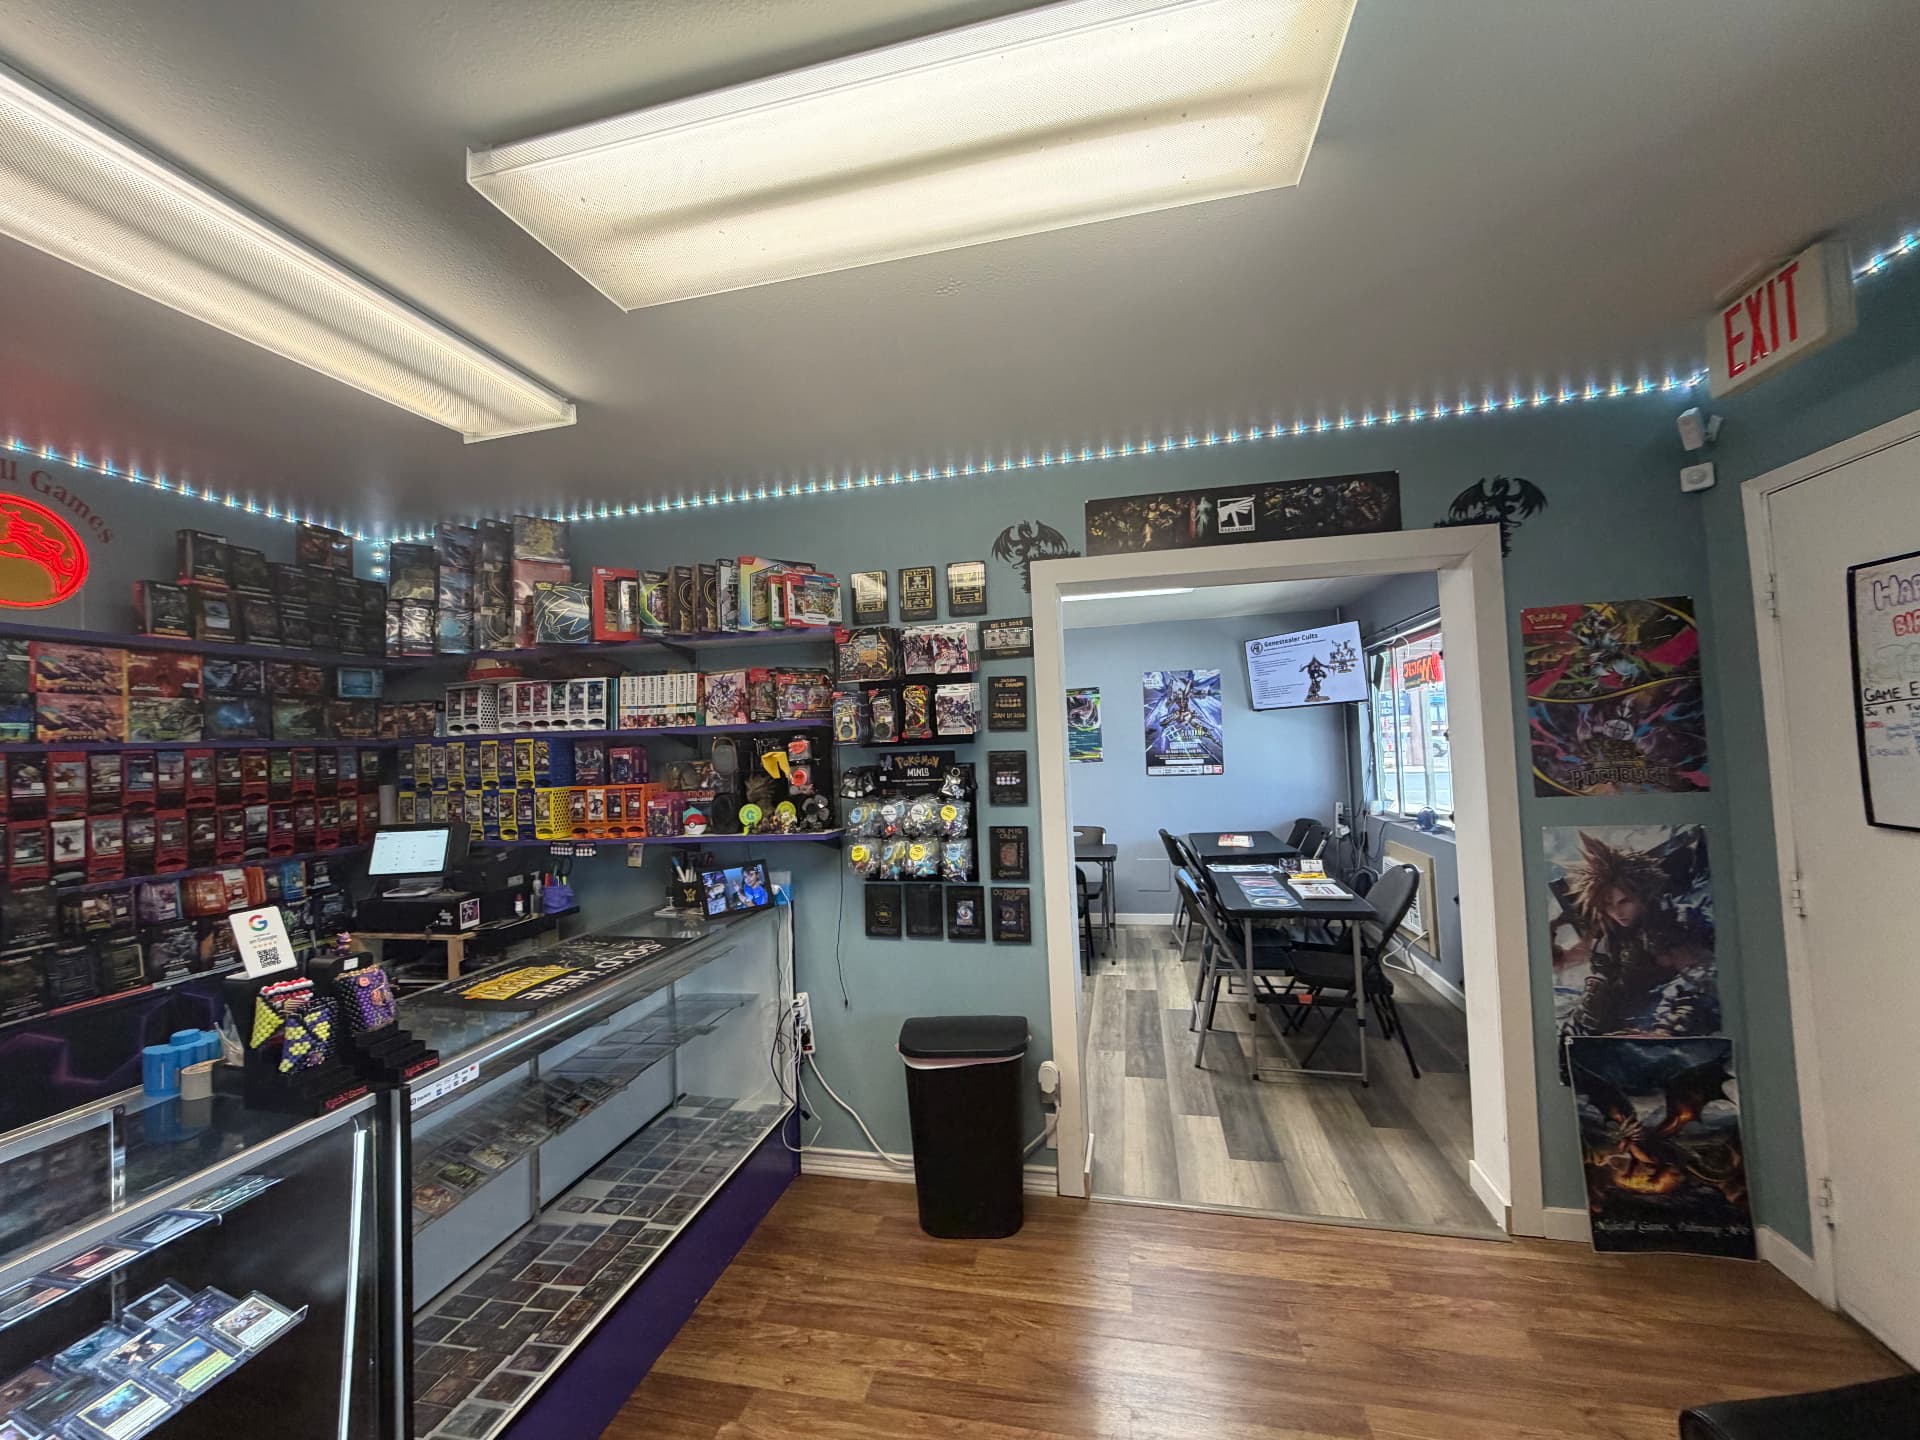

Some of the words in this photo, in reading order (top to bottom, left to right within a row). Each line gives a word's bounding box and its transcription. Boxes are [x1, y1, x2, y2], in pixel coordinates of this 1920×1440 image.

[1723, 261, 1800, 380] EXIT
[30, 469, 113, 544] Games
[1264, 636, 1300, 648] Genestealer
[1301, 633, 1319, 641] Cults
[1864, 687, 1902, 702] GAME
[907, 767, 930, 777] MINIS
[595, 943, 660, 969] SOLD
[515, 970, 601, 1000] HERE
